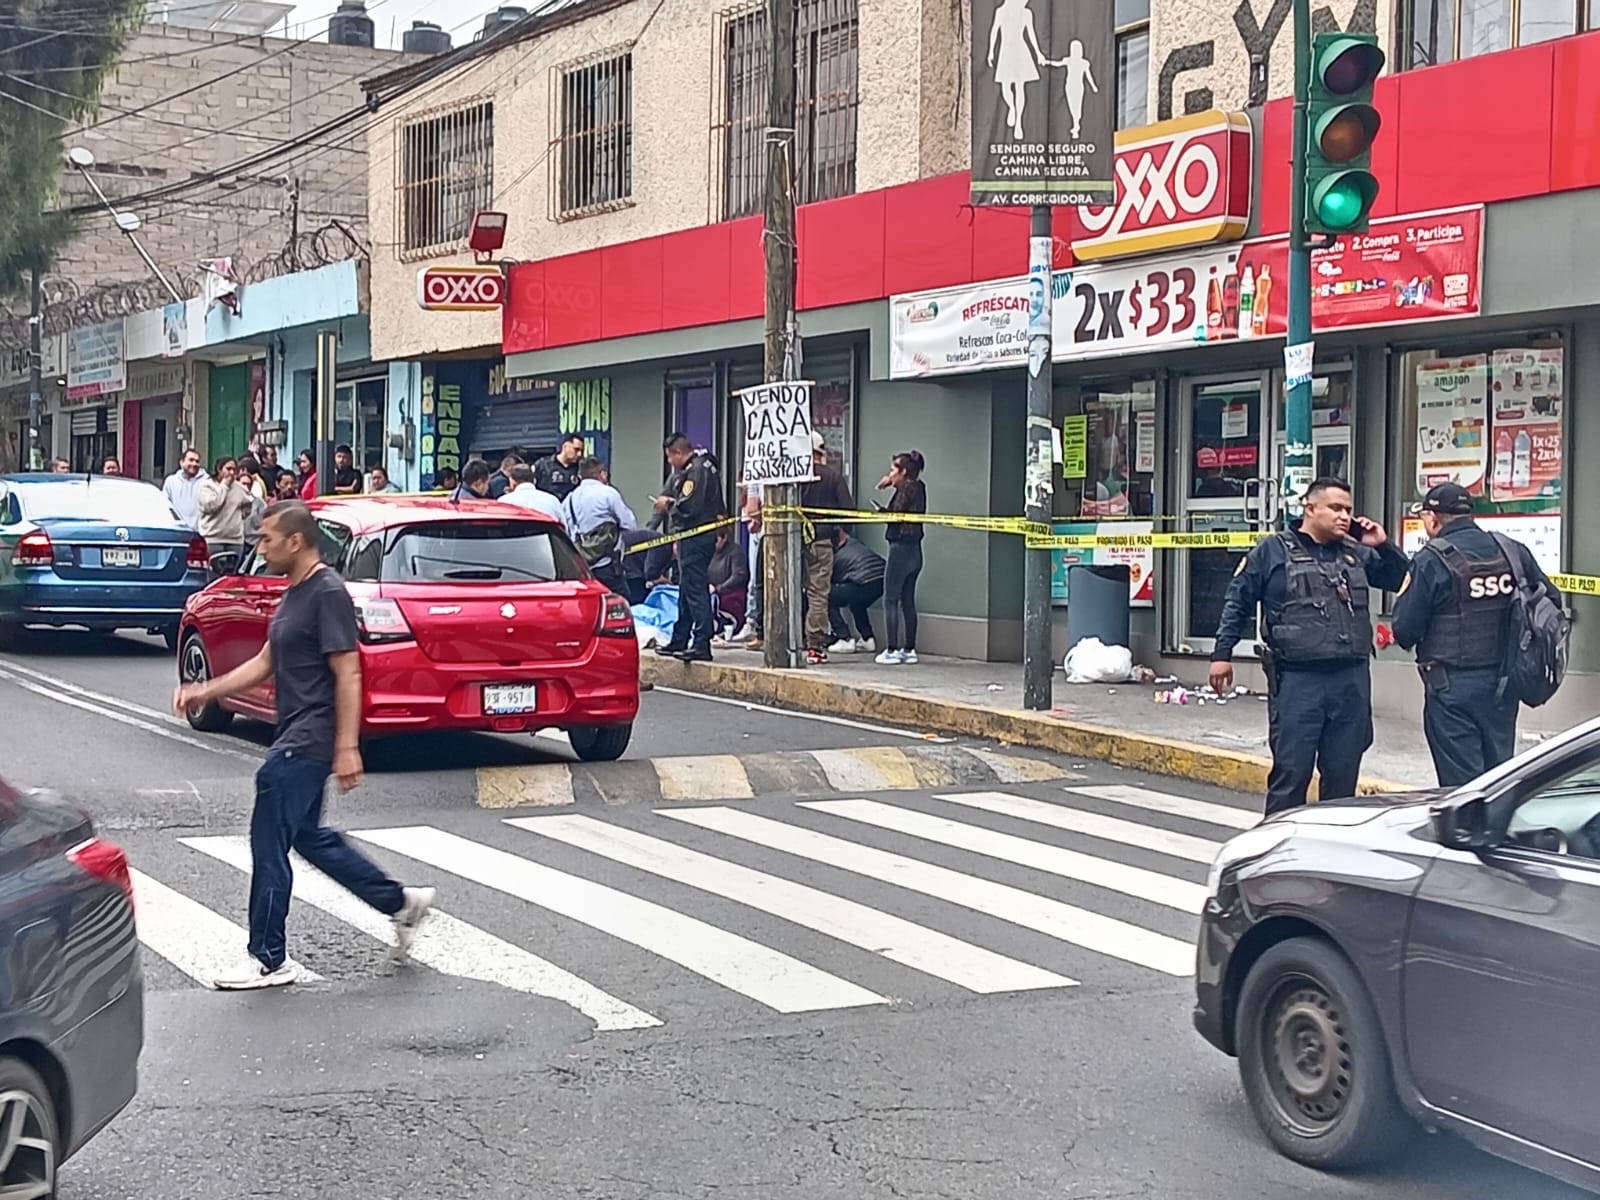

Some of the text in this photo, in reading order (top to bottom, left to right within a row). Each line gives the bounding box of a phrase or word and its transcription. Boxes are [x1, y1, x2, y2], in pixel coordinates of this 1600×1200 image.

[990, 144, 1095, 154] SENDERO SEGURO
[1000, 155, 1085, 166] CAMINA LIBRE,
[995, 167, 1089, 176] CAMINA SEGURA
[992, 194, 1093, 204] AV. CORREGIDORA
[427, 275, 499, 303] OXXO
[959, 329, 1028, 348] Refrescos Coca-Col
[1434, 375, 1470, 387] amazon
[742, 385, 806, 406] VENDO
[559, 377, 610, 434] COPIAS
[748, 405, 809, 440] CASA
[748, 440, 788, 457] URGE
[1097, 537, 1127, 546] PROHIBIDO
[1137, 536, 1152, 545] PASO
[1171, 534, 1230, 544] PROHIBIDO EL PASO
[1469, 574, 1514, 598] SSC
[1578, 578, 1596, 591] PASO
